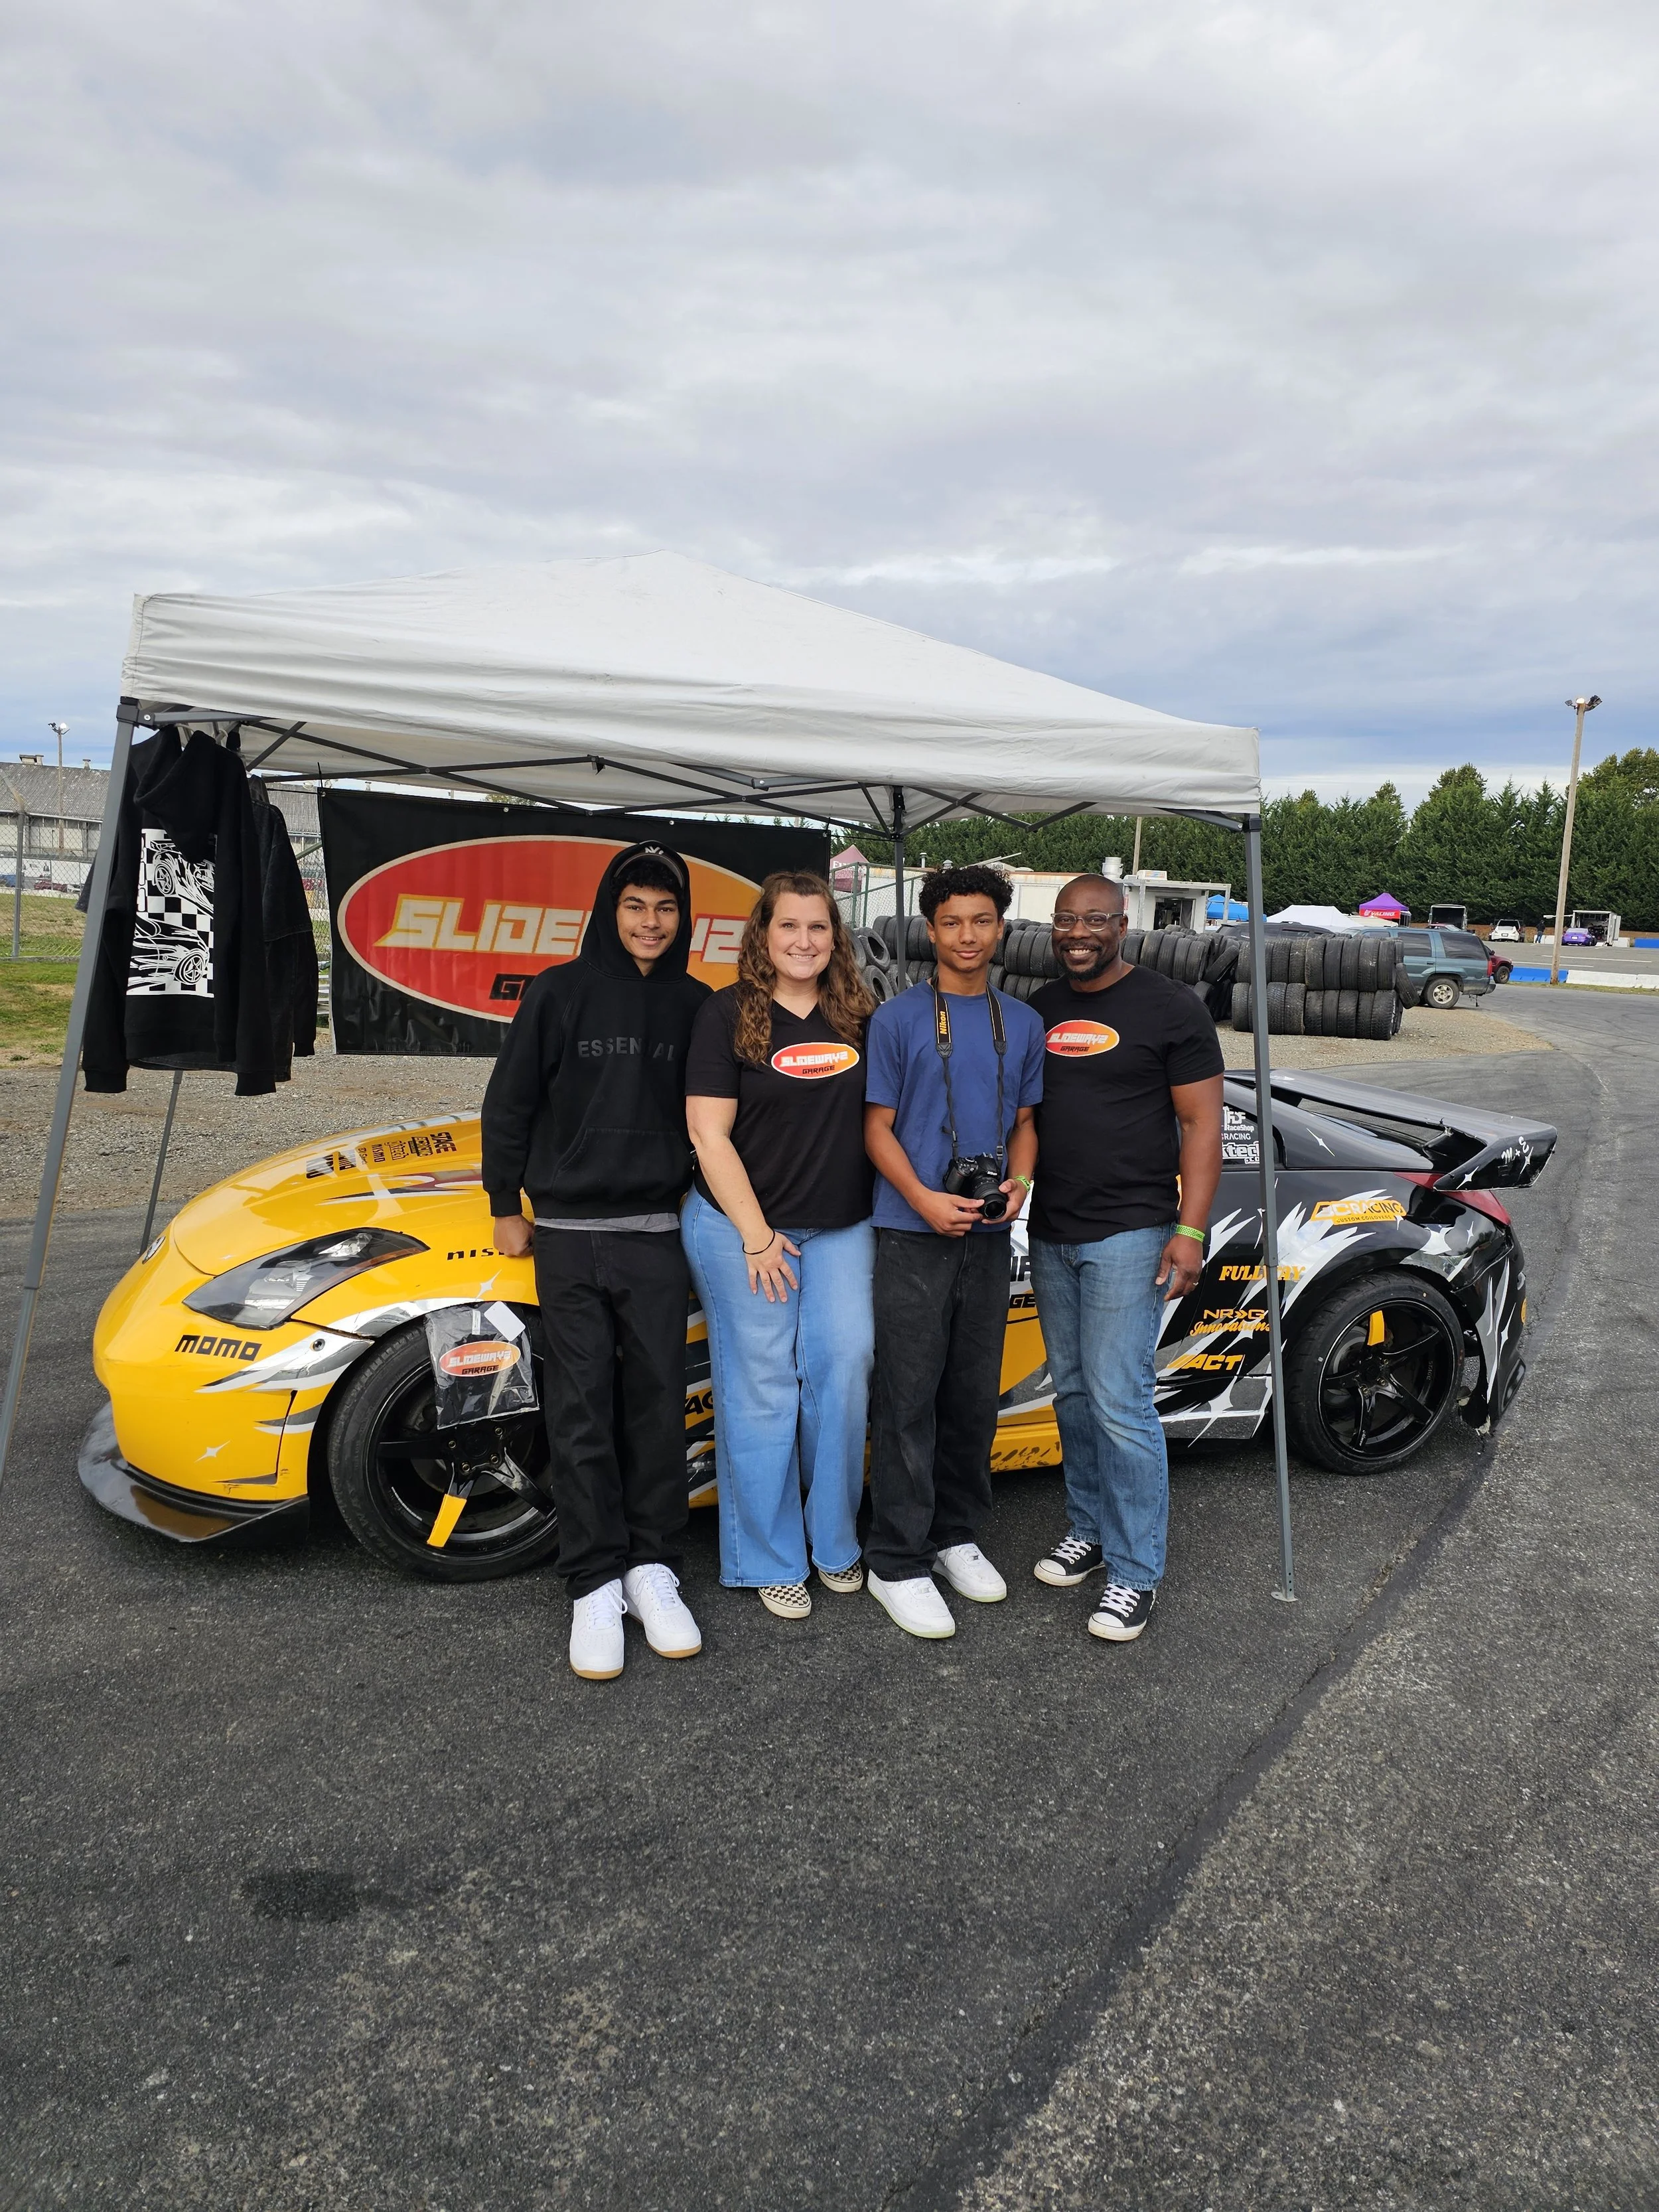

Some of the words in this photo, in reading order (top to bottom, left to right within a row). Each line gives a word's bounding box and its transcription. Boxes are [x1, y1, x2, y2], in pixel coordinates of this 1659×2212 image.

[802, 1065, 835, 1074] GARAGE
[429, 1132, 457, 1154] STAGE
[462, 1364, 499, 1375] GARAGE
